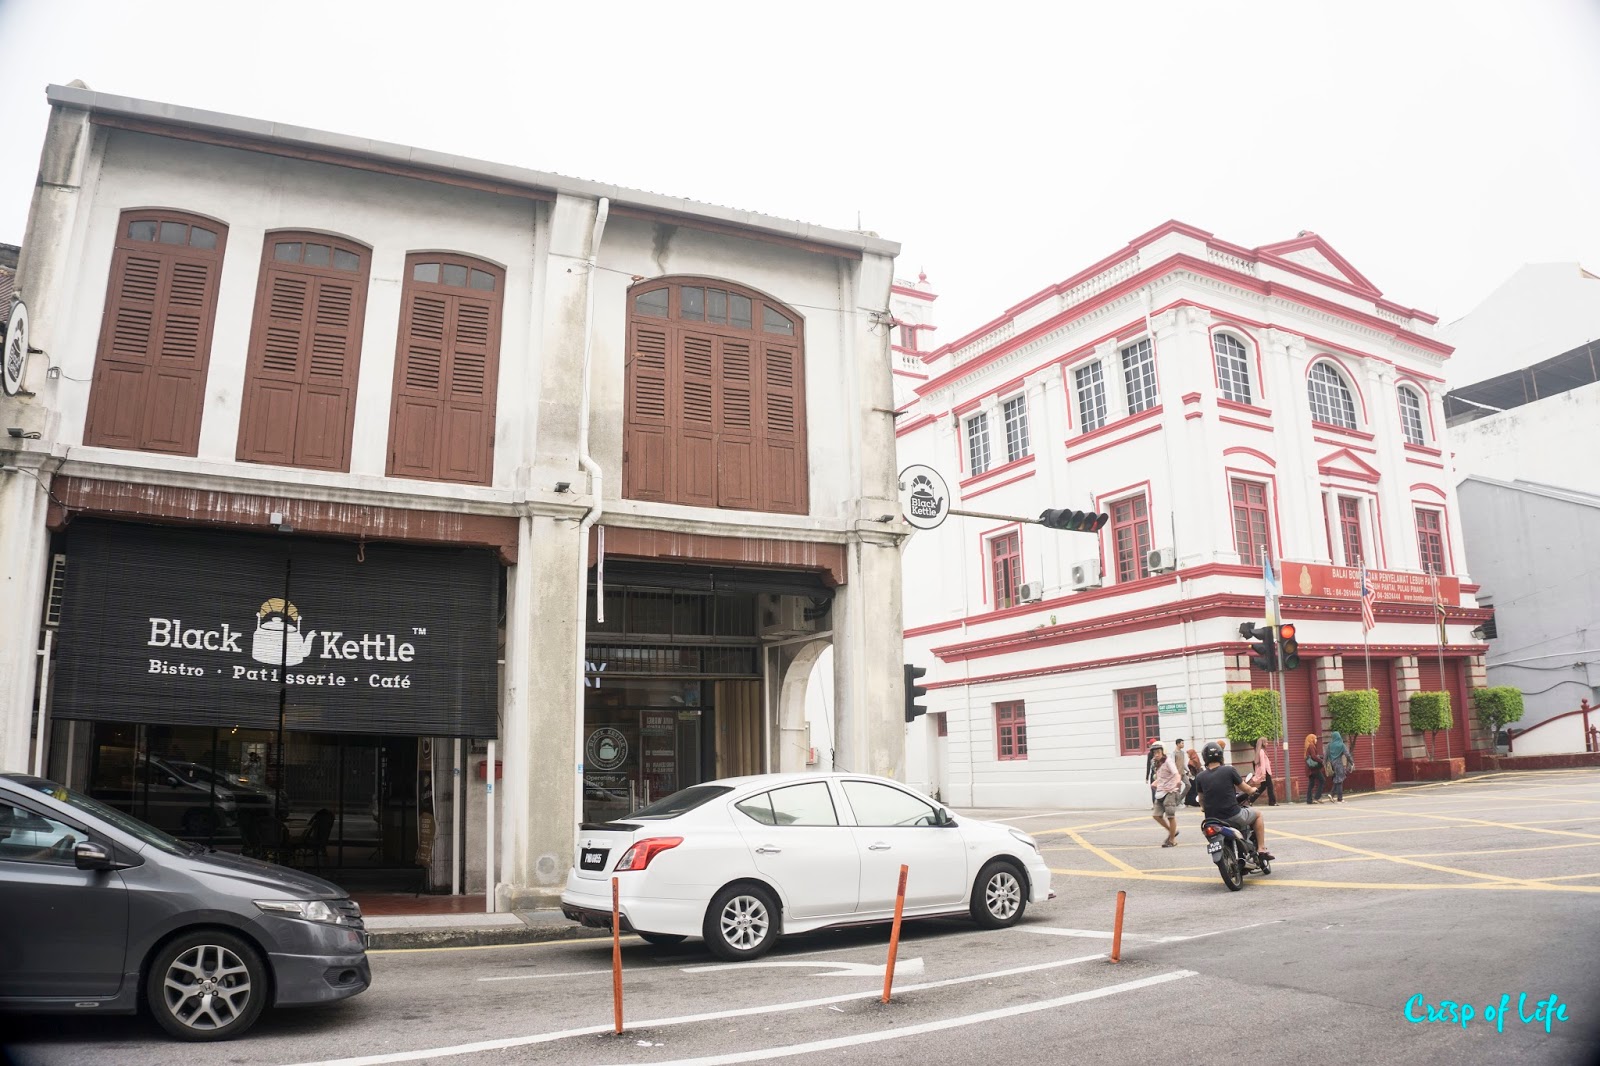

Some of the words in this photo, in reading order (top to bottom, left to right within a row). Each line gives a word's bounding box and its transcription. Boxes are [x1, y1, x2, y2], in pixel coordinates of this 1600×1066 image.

[912, 498, 936, 508] Black
[912, 506, 936, 516] Kettle
[1332, 568, 1348, 578] BALAI
[1379, 572, 1408, 584] PENYELAMAT
[1410, 576, 1424, 585] LEBUH
[1397, 585, 1409, 593] PULAU
[148, 617, 242, 653] Black
[320, 631, 415, 662] Kettle
[148, 659, 204, 676] Bistro
[232, 665, 346, 686] Patisserie
[368, 674, 411, 688] Café
